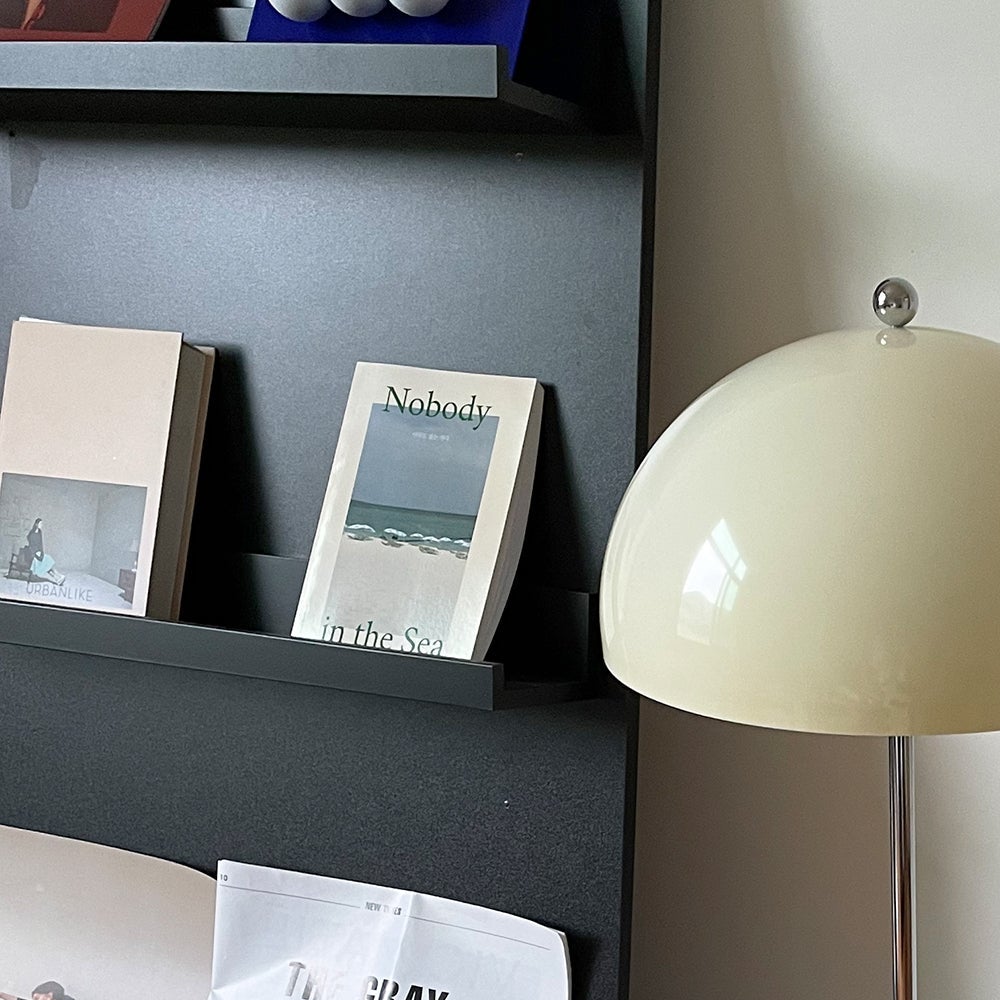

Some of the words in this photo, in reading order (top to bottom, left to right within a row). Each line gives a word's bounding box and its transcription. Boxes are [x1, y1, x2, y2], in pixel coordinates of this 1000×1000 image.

[383, 386, 492, 430] Nobody
[26, 583, 93, 601] URBANLIKE
[321, 616, 345, 643] in
[354, 620, 393, 650] the
[401, 626, 443, 656] Sea
[220, 873, 228, 881] 10
